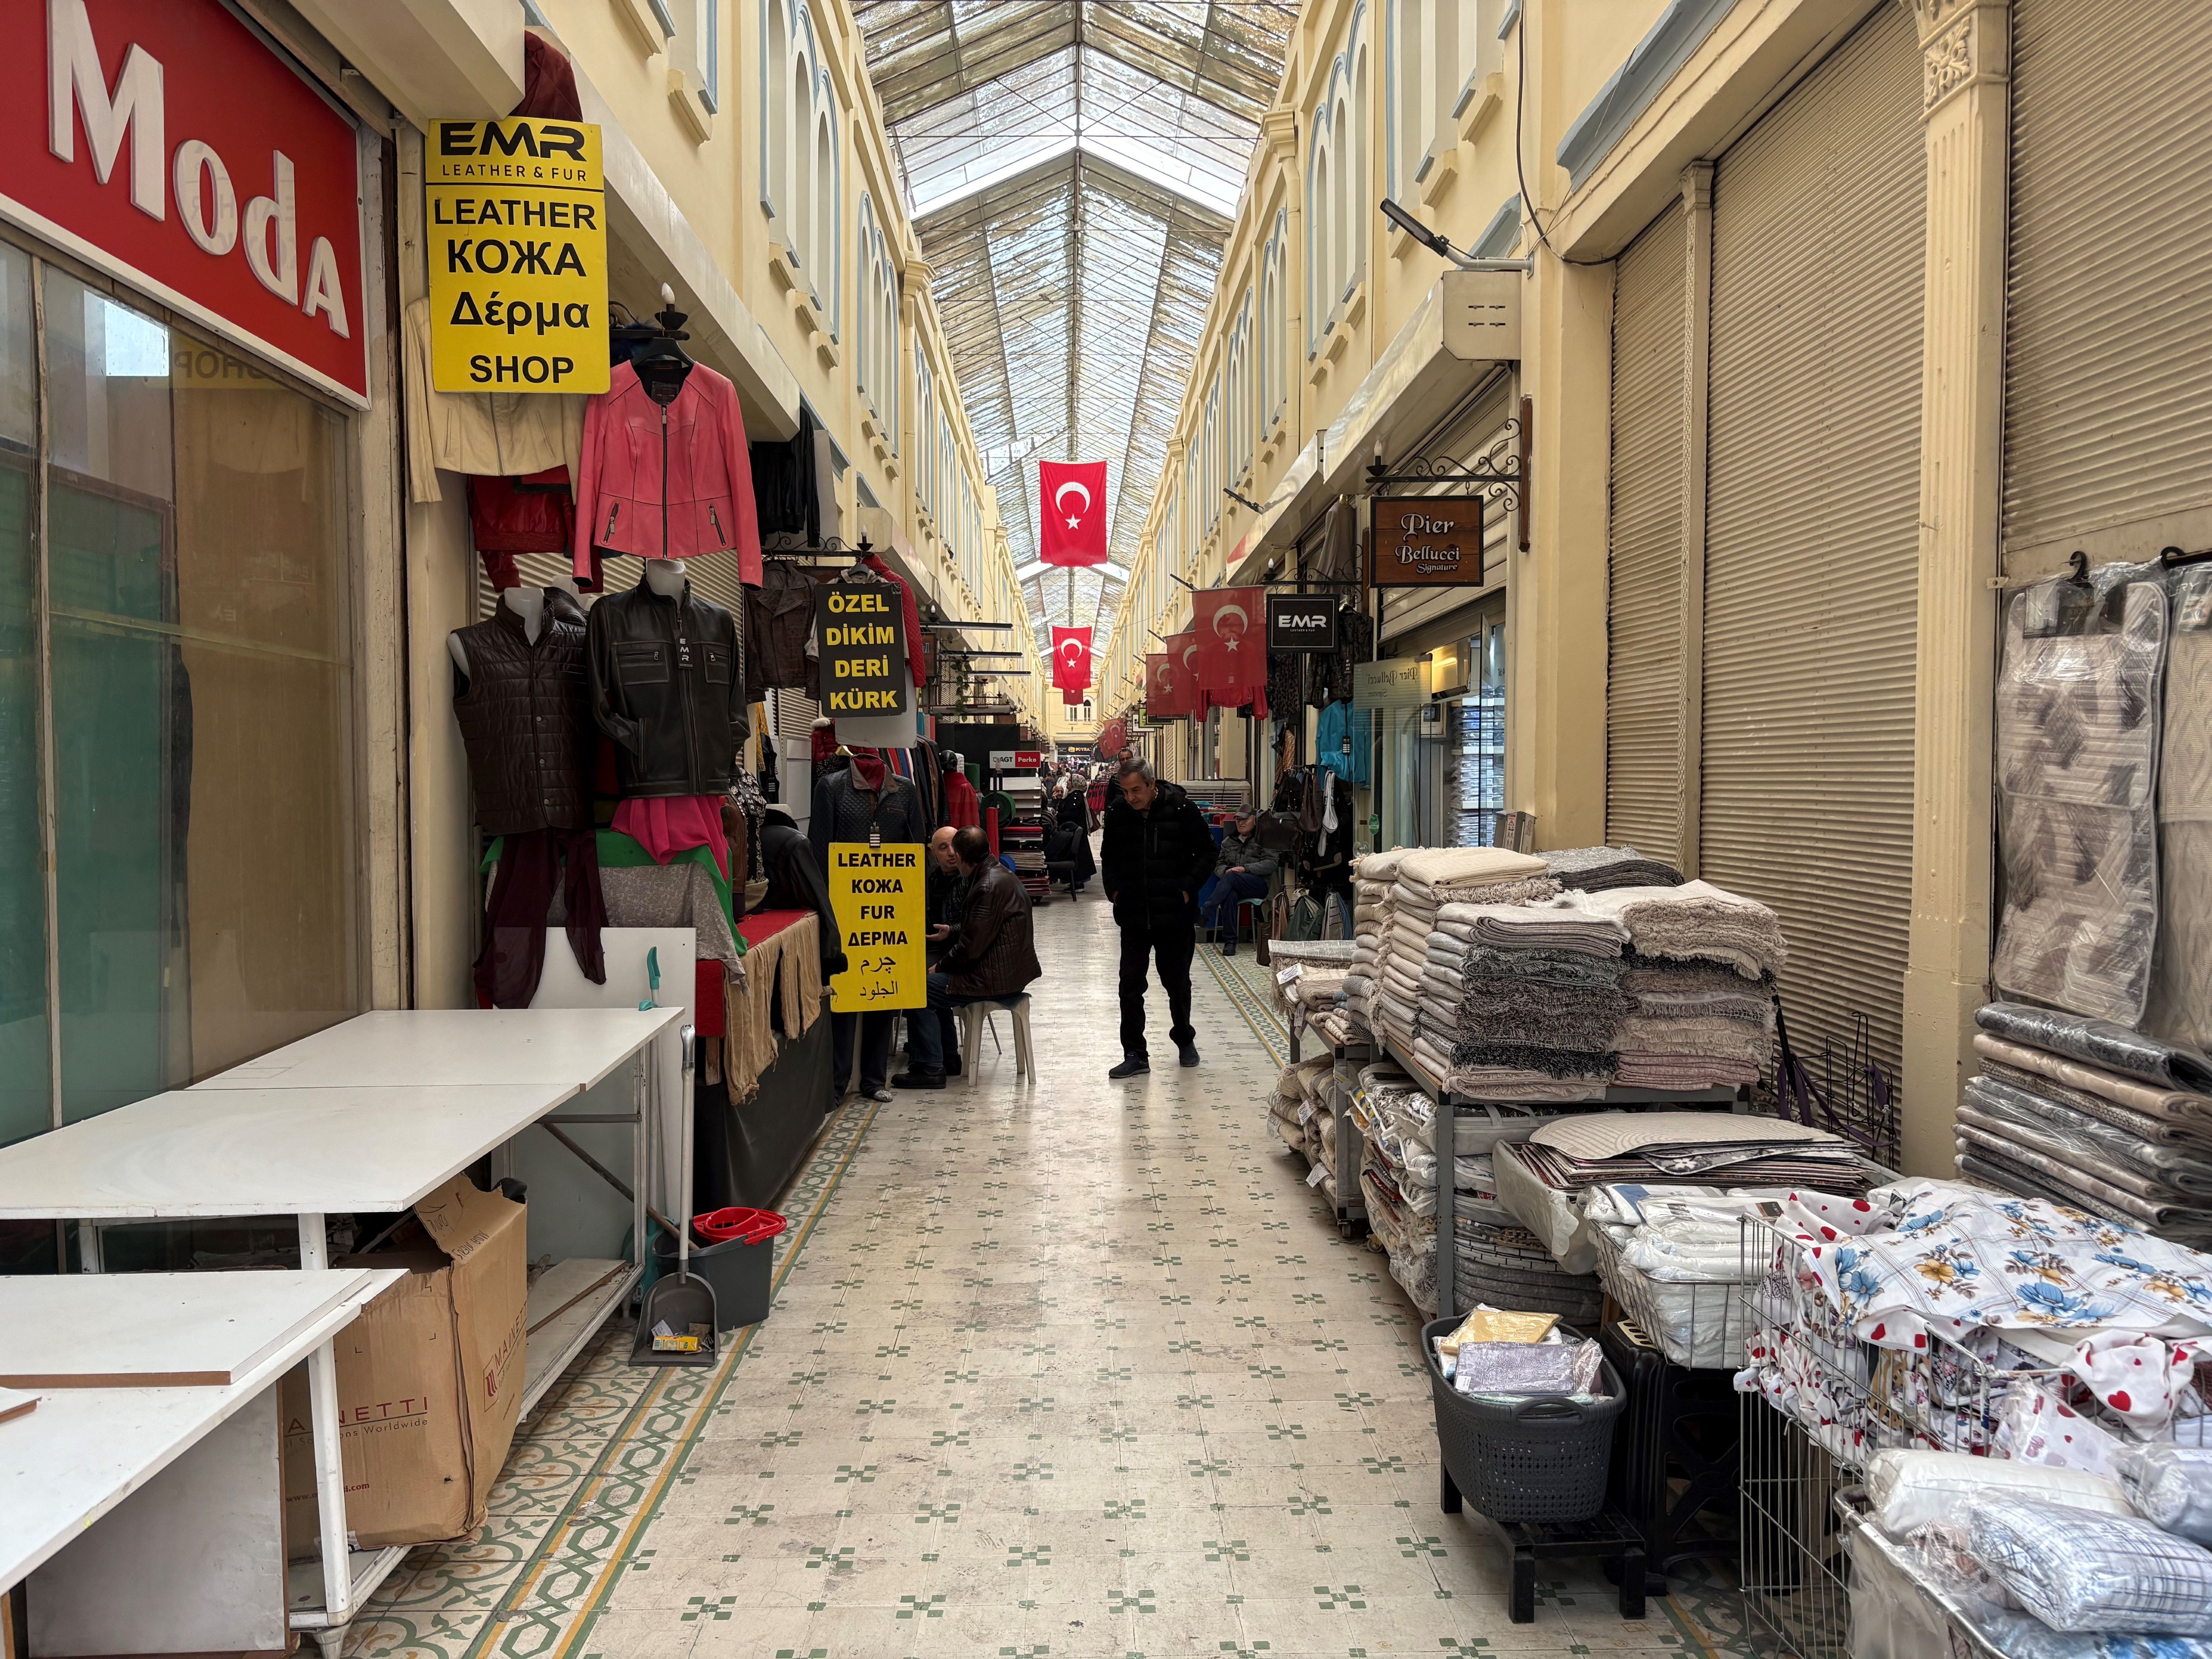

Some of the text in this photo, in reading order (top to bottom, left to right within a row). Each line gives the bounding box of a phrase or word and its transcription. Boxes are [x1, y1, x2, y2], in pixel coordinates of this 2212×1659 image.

[441, 121, 587, 162] EMR
[442, 164, 586, 181] LEATHER & FUR
[435, 199, 597, 230] LEATHER
[447, 239, 587, 277] КОЖА
[450, 291, 589, 335] Δέρμα
[469, 355, 574, 384] SHOP
[1400, 513, 1455, 542] Pier
[1395, 545, 1461, 564] Bellucci
[1416, 563, 1458, 574] Signature
[828, 592, 889, 613] ÖZEL
[1278, 615, 1327, 627] EMR
[826, 623, 894, 646] DİKİM
[835, 655, 889, 678] DERİ
[830, 688, 898, 710] KÜRK
[838, 853, 916, 867] LEATHER
[851, 879, 904, 893] КОЖА
[861, 905, 895, 920] FUR
[848, 931, 908, 947] ΔΕΡΜΑ
[860, 980, 898, 1001] الجلود
[364, 1418, 428, 1434] Worldwide
